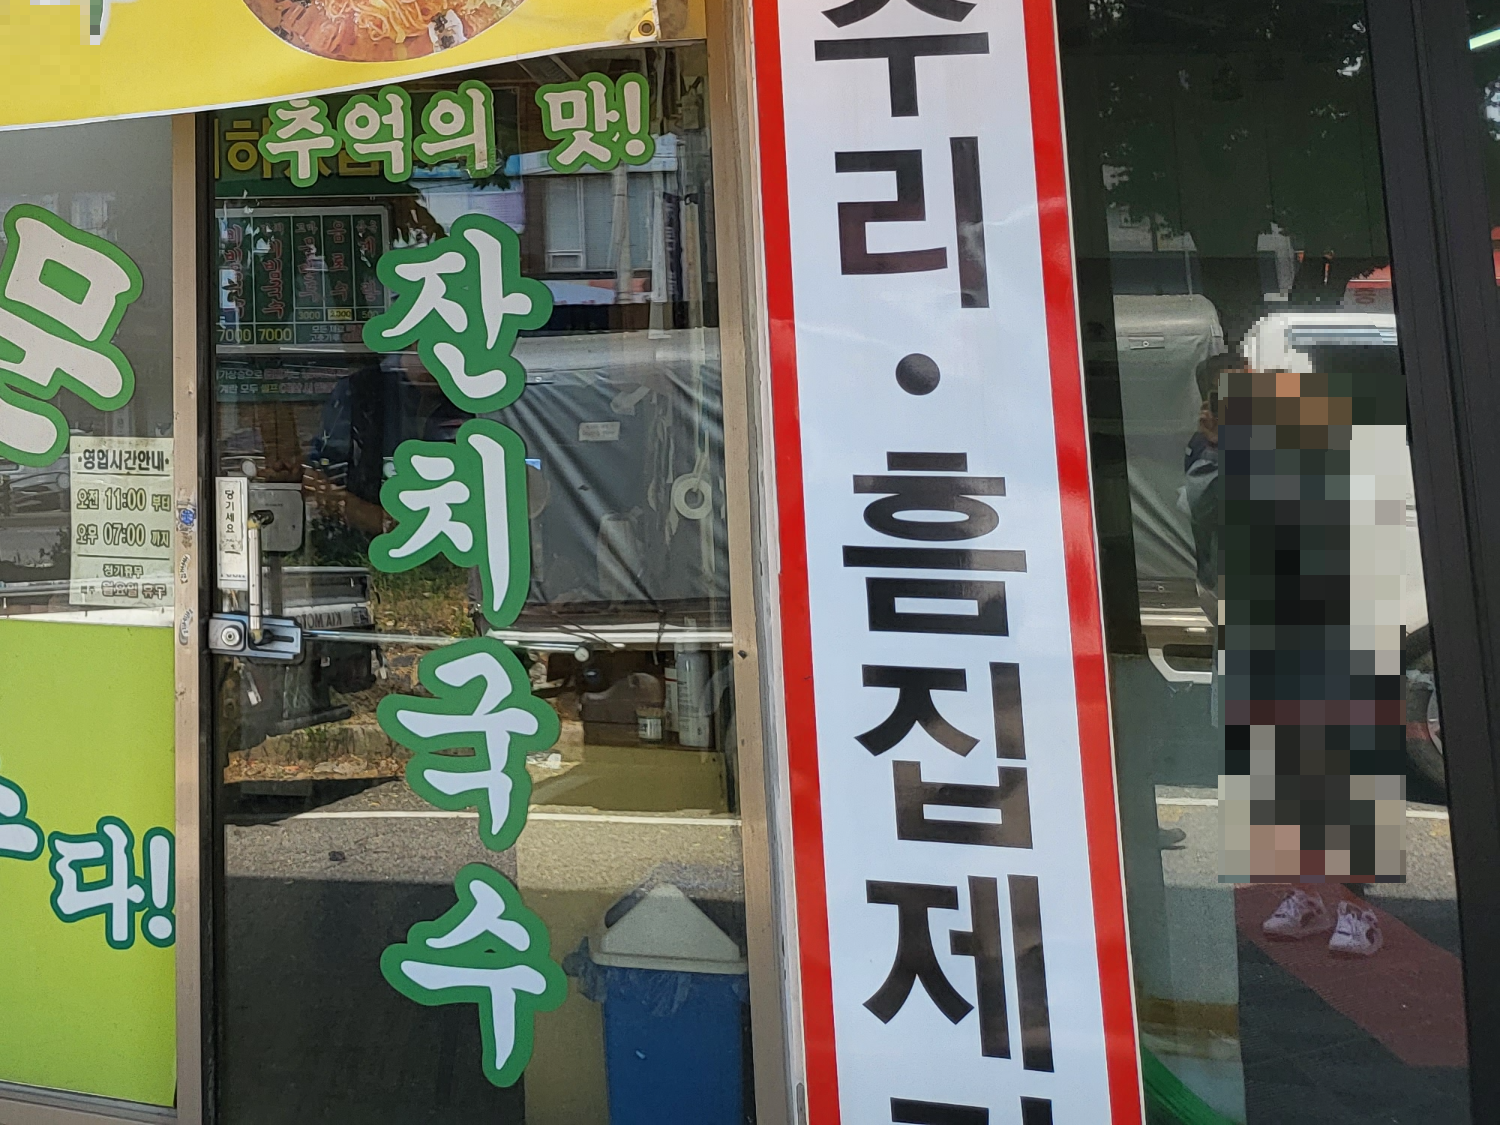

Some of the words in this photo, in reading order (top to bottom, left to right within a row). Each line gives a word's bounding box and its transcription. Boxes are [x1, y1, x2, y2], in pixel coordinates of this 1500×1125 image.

[262, 85, 493, 180] 추억의
[539, 76, 650, 168] 맛!
[217, 328, 252, 342] 7000
[257, 328, 292, 342] 7000
[240, 383, 259, 394] 모두
[76, 487, 100, 511] 오전
[104, 486, 147, 512] 11:00
[151, 493, 172, 513] 부터
[224, 489, 235, 533] 당기세요
[76, 522, 99, 547] 오후
[103, 521, 147, 548] 07:00
[150, 529, 171, 549] 까지
[102, 563, 144, 579] 정기휴무
[101, 580, 139, 598] 월요일
[372, 221, 557, 1078] 잔치국수
